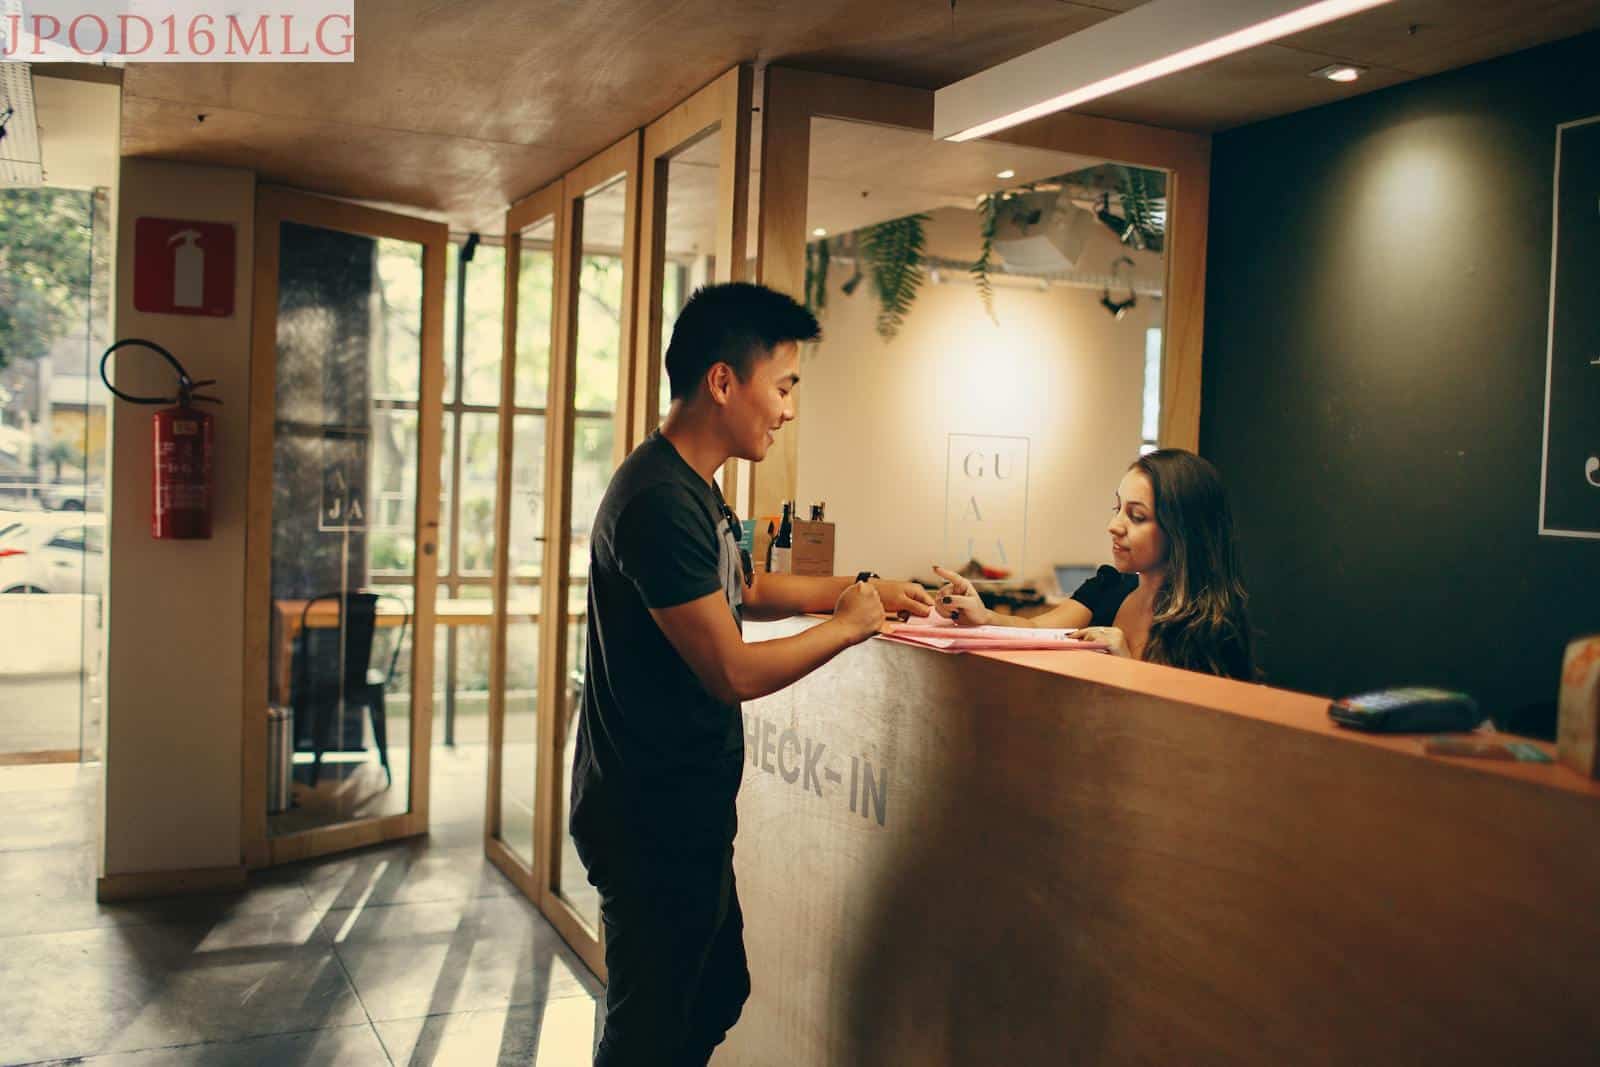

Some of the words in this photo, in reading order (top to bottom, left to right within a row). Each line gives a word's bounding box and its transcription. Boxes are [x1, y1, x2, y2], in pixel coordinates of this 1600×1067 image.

[963, 450, 1015, 480] GU
[328, 498, 363, 519] JA
[961, 495, 983, 521] A
[743, 713, 888, 827] HECK-IN
